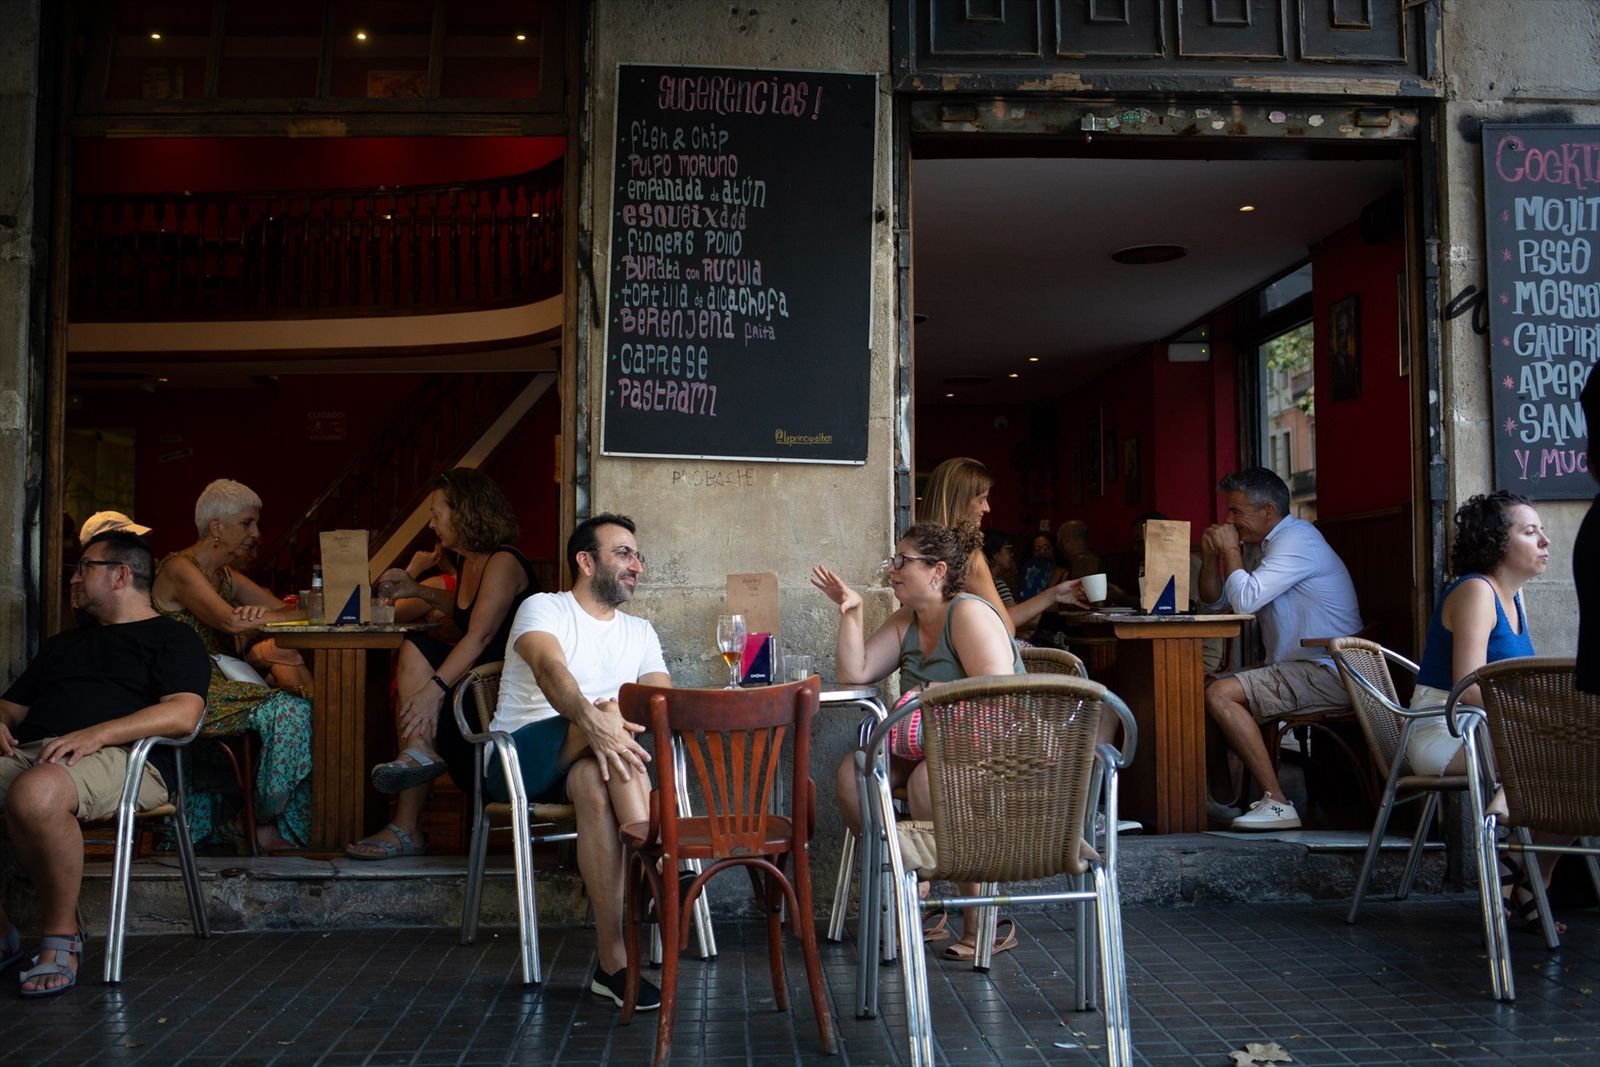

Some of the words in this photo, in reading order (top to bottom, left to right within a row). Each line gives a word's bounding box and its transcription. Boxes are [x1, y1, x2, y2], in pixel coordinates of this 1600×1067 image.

[673, 127, 686, 150] &
[1496, 135, 1600, 190] COCKT
[1512, 279, 1600, 319] MOSCO
[1514, 449, 1530, 480] Y
